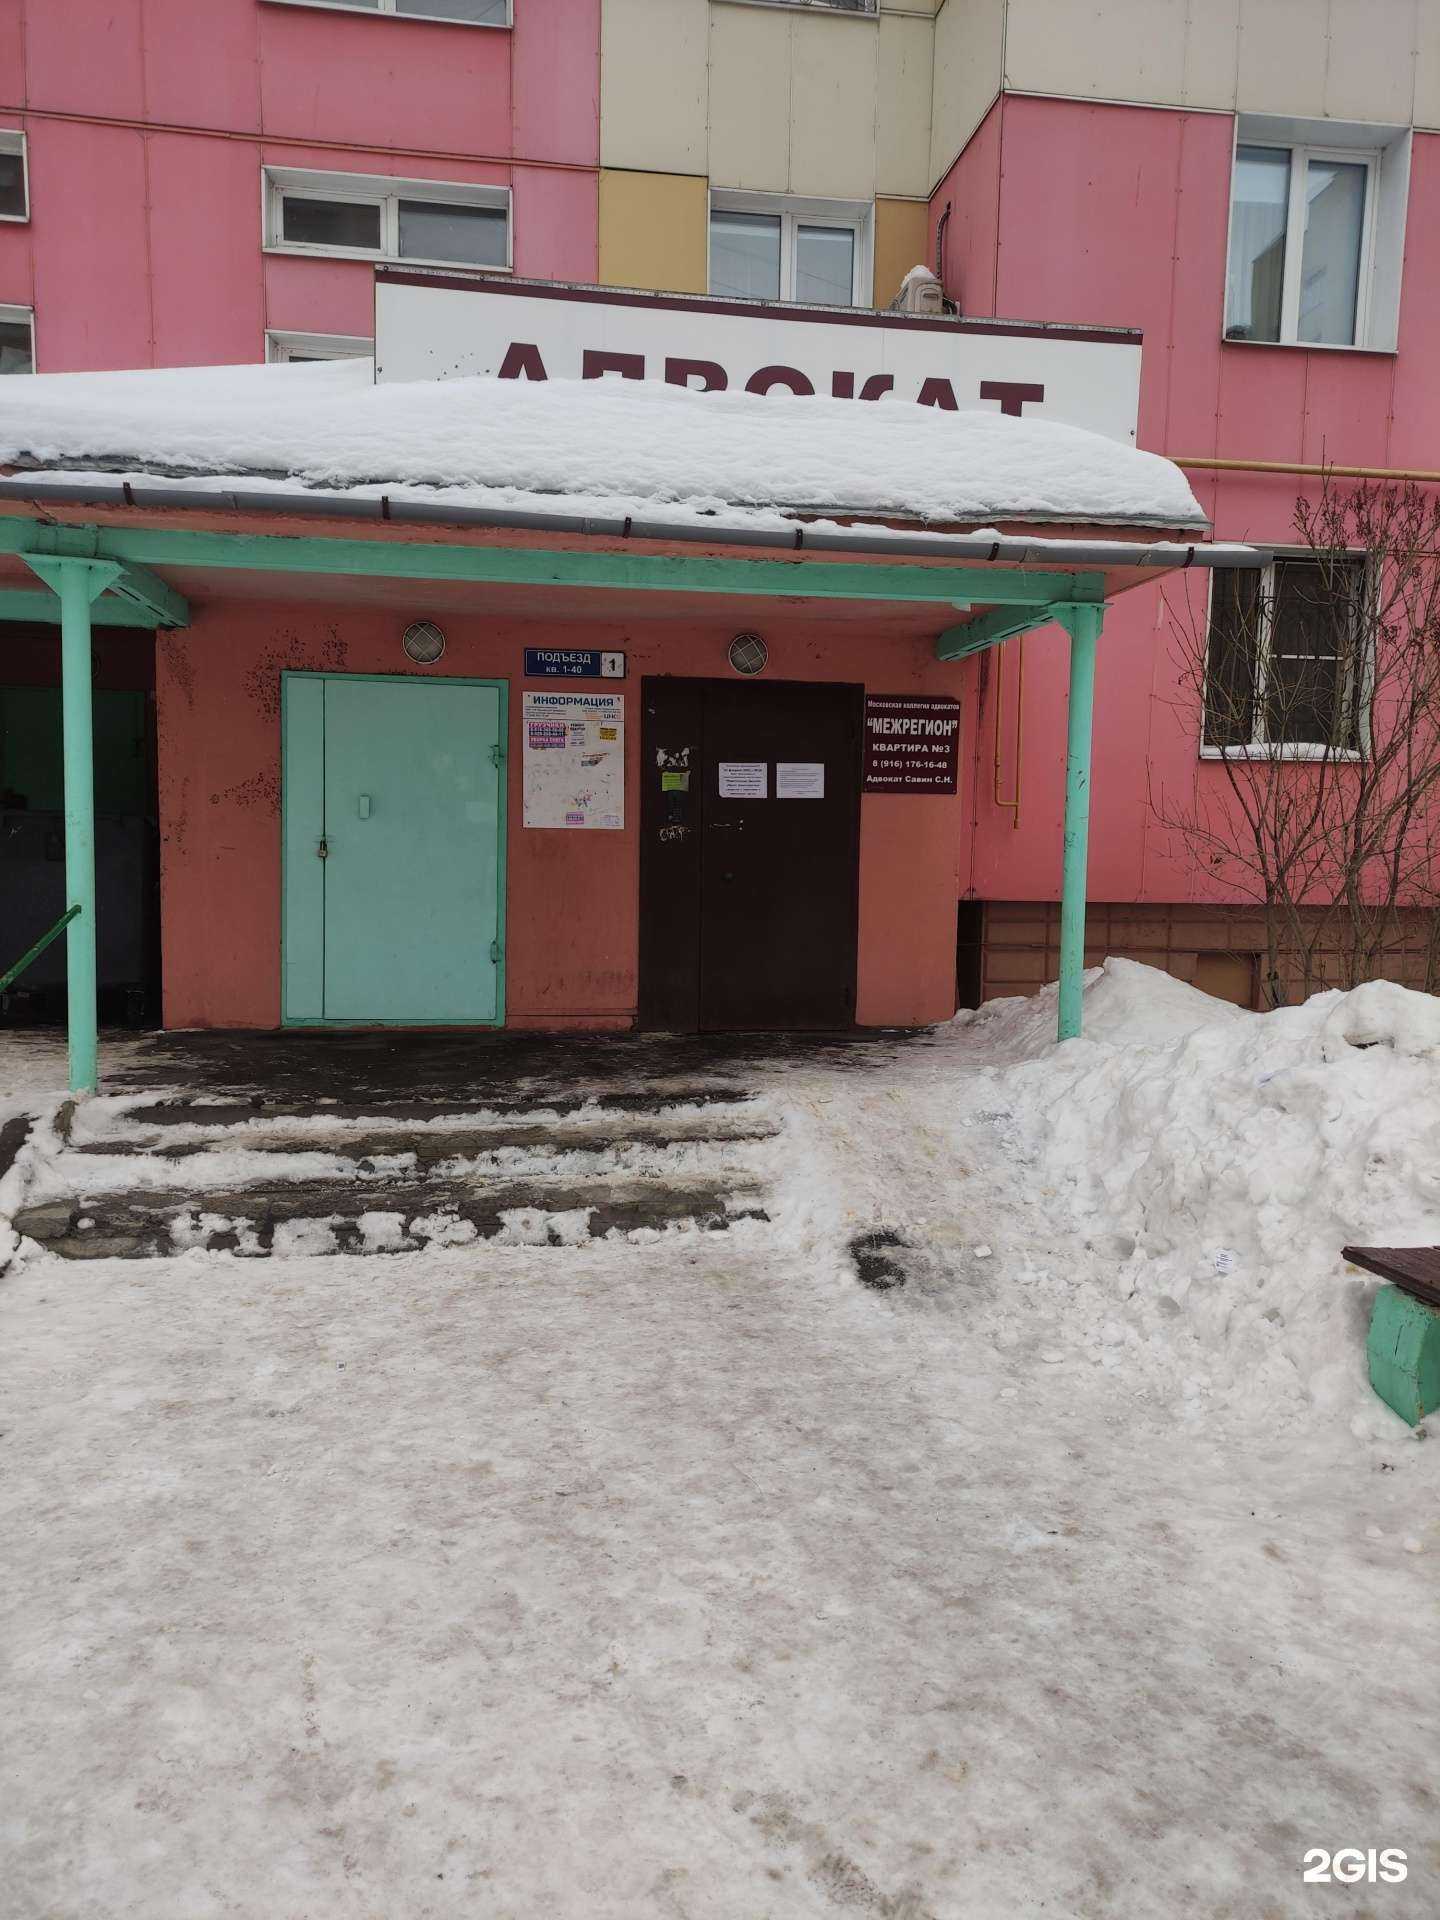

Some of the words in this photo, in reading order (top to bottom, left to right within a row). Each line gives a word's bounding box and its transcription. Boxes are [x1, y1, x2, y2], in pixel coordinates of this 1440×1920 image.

[537, 652, 591, 664] ПОДЪЕЗД
[608, 658, 616, 671] 1
[533, 695, 614, 708] ИНФОРМАЦИЯ
[867, 700, 901, 708] Московская
[930, 703, 960, 711] адвокатов
[867, 717, 958, 736] “МЕЖРЕГИОН”
[872, 743, 929, 752] КВАРТИРА
[931, 744, 950, 753] №3
[872, 759, 878, 767] 8
[880, 760, 903, 768] (916)
[866, 774, 902, 783] Адвокат
[905, 775, 932, 783] Савин
